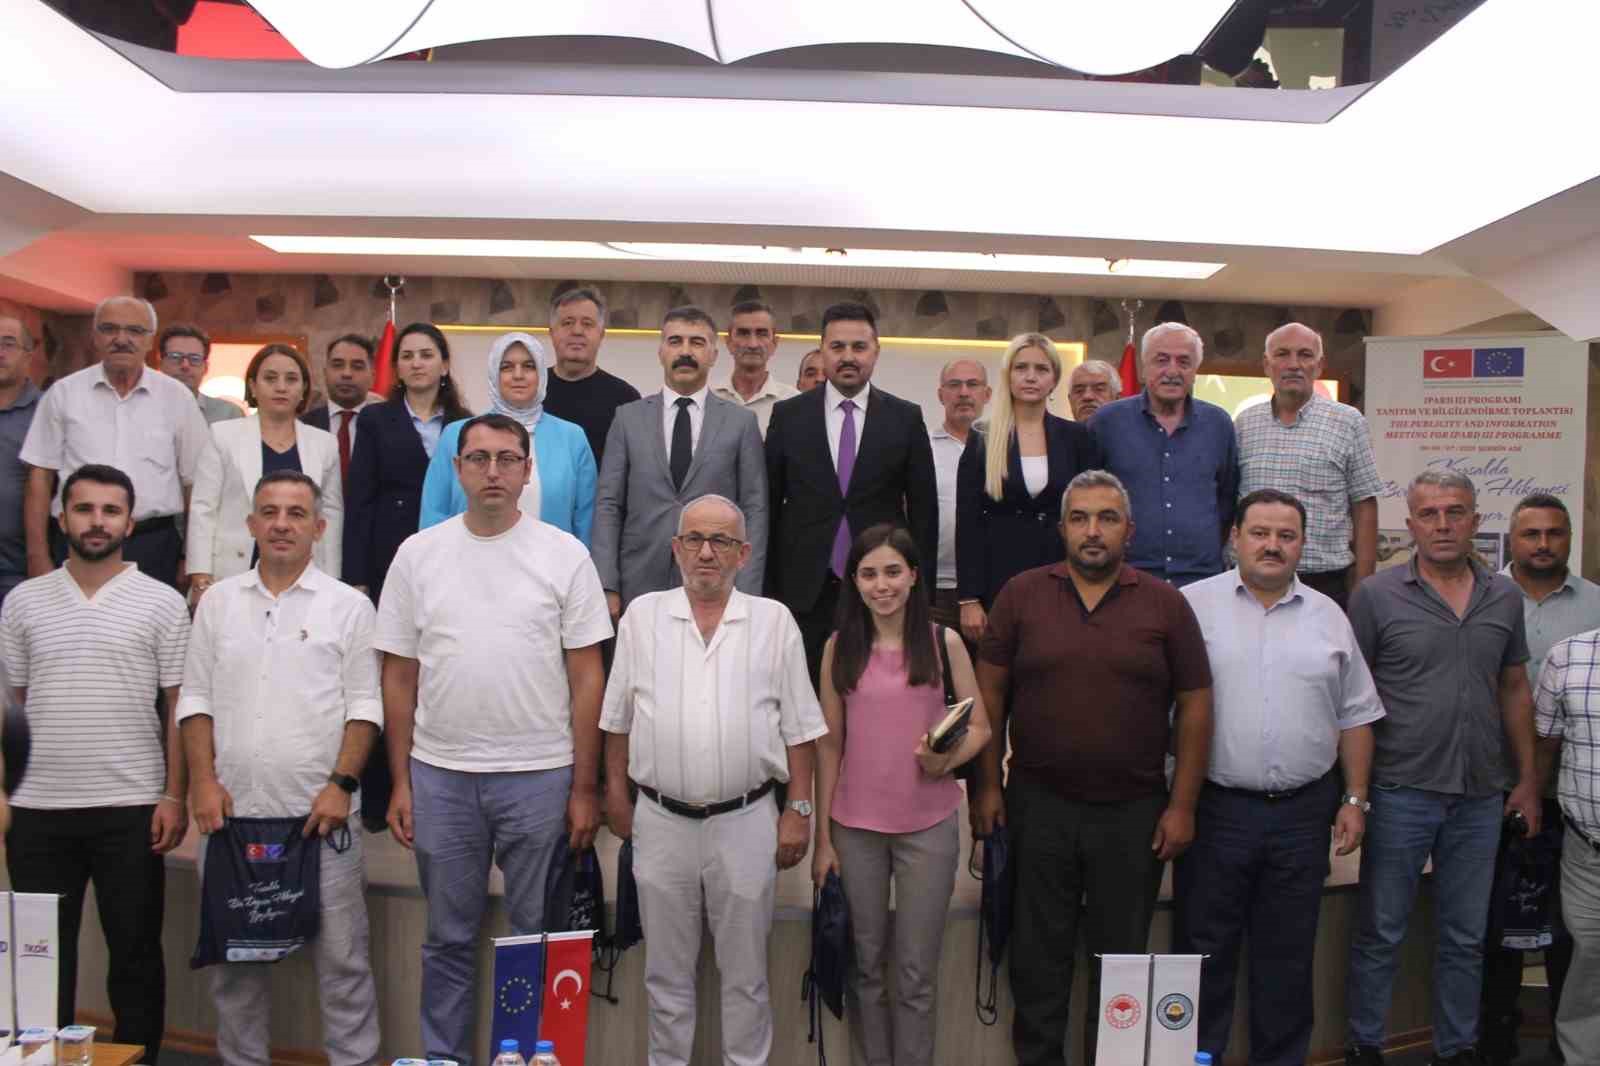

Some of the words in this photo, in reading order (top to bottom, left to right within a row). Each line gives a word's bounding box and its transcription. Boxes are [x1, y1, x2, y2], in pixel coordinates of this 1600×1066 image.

[1376, 407, 1417, 416] TANITIM
[1418, 407, 1431, 415] VE
[1512, 407, 1573, 416] TOPLANTISI
[1463, 420, 1484, 428] AND
[1485, 420, 1558, 428] INFORMATION
[1384, 431, 1429, 440] MEETING
[1430, 431, 1448, 439] FOR
[1495, 431, 1562, 440] PROGRAMME
